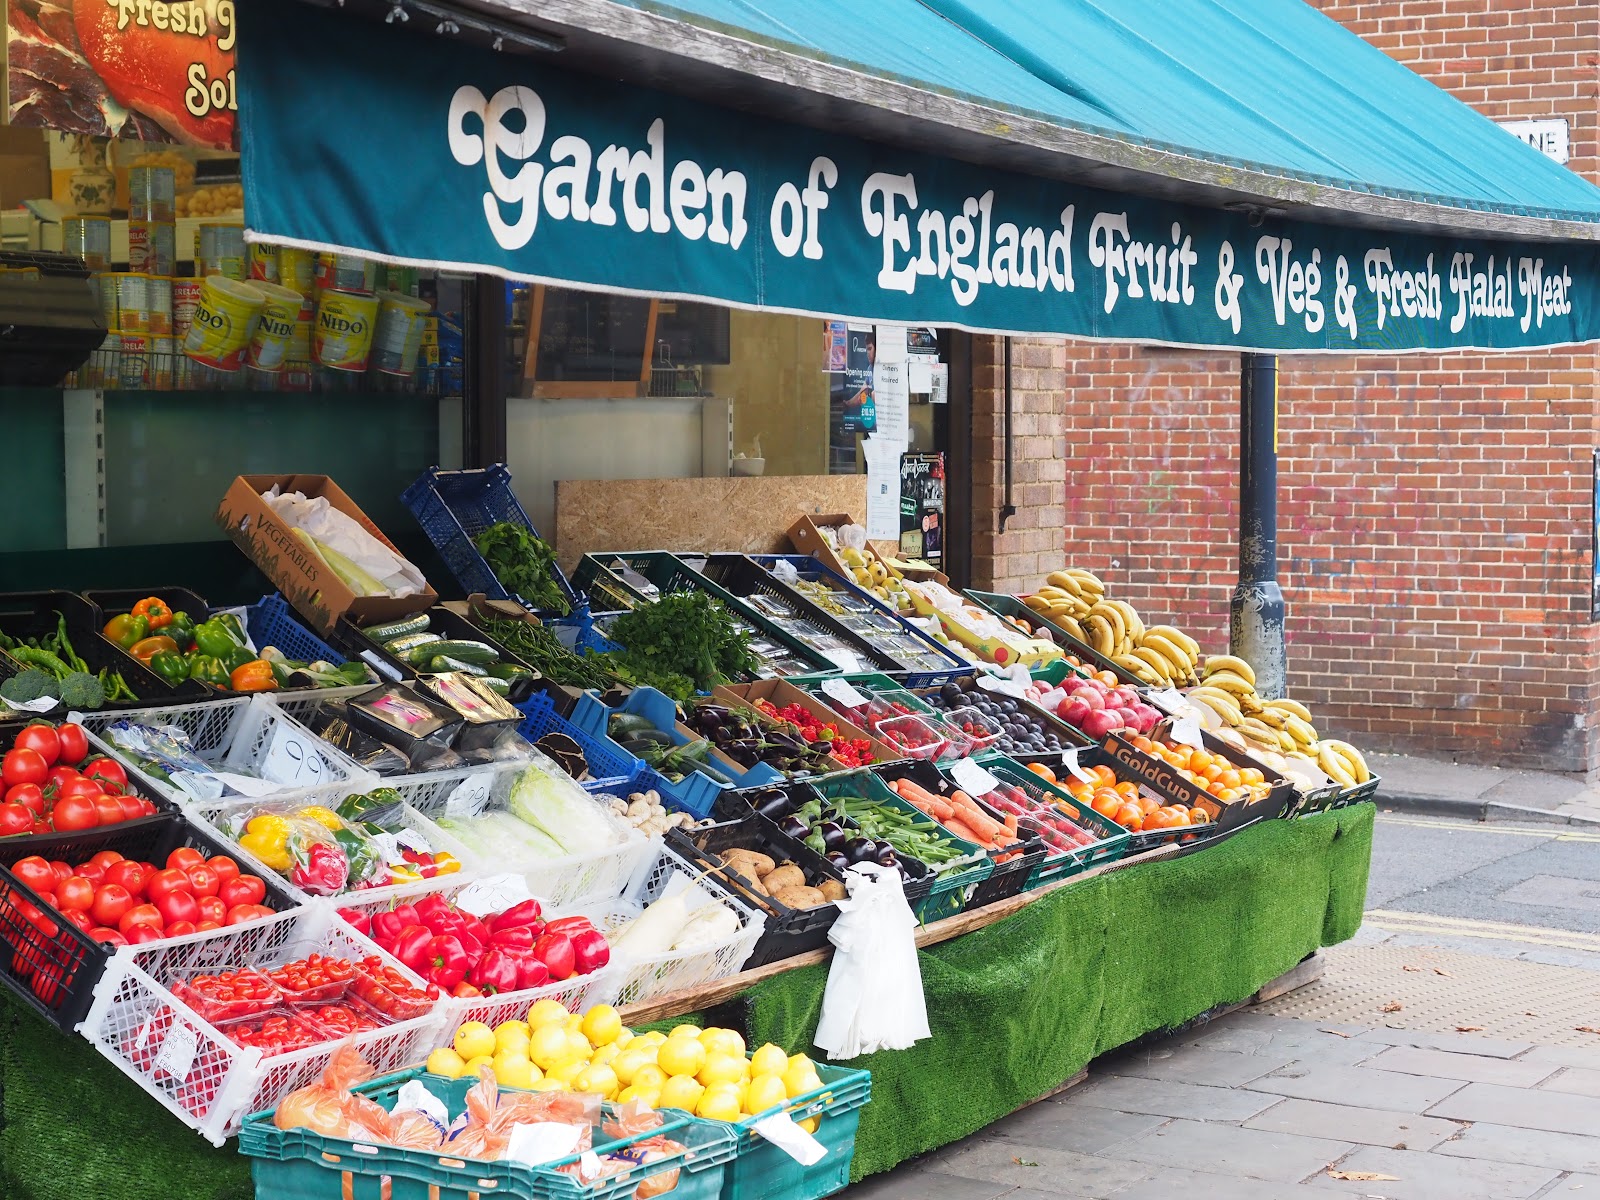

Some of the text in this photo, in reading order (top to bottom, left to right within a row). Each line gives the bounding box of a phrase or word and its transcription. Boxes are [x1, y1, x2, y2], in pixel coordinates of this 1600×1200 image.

[1517, 132, 1556, 152] NE
[447, 84, 1573, 340] Garden of England Fruit & Veg & Fresh Halal Meat
[319, 311, 363, 334] NIDO
[845, 367, 863, 378] Opening
[257, 513, 319, 582] VEGETABLES
[285, 740, 322, 786] 99
[1116, 748, 1191, 803] GoldCup
